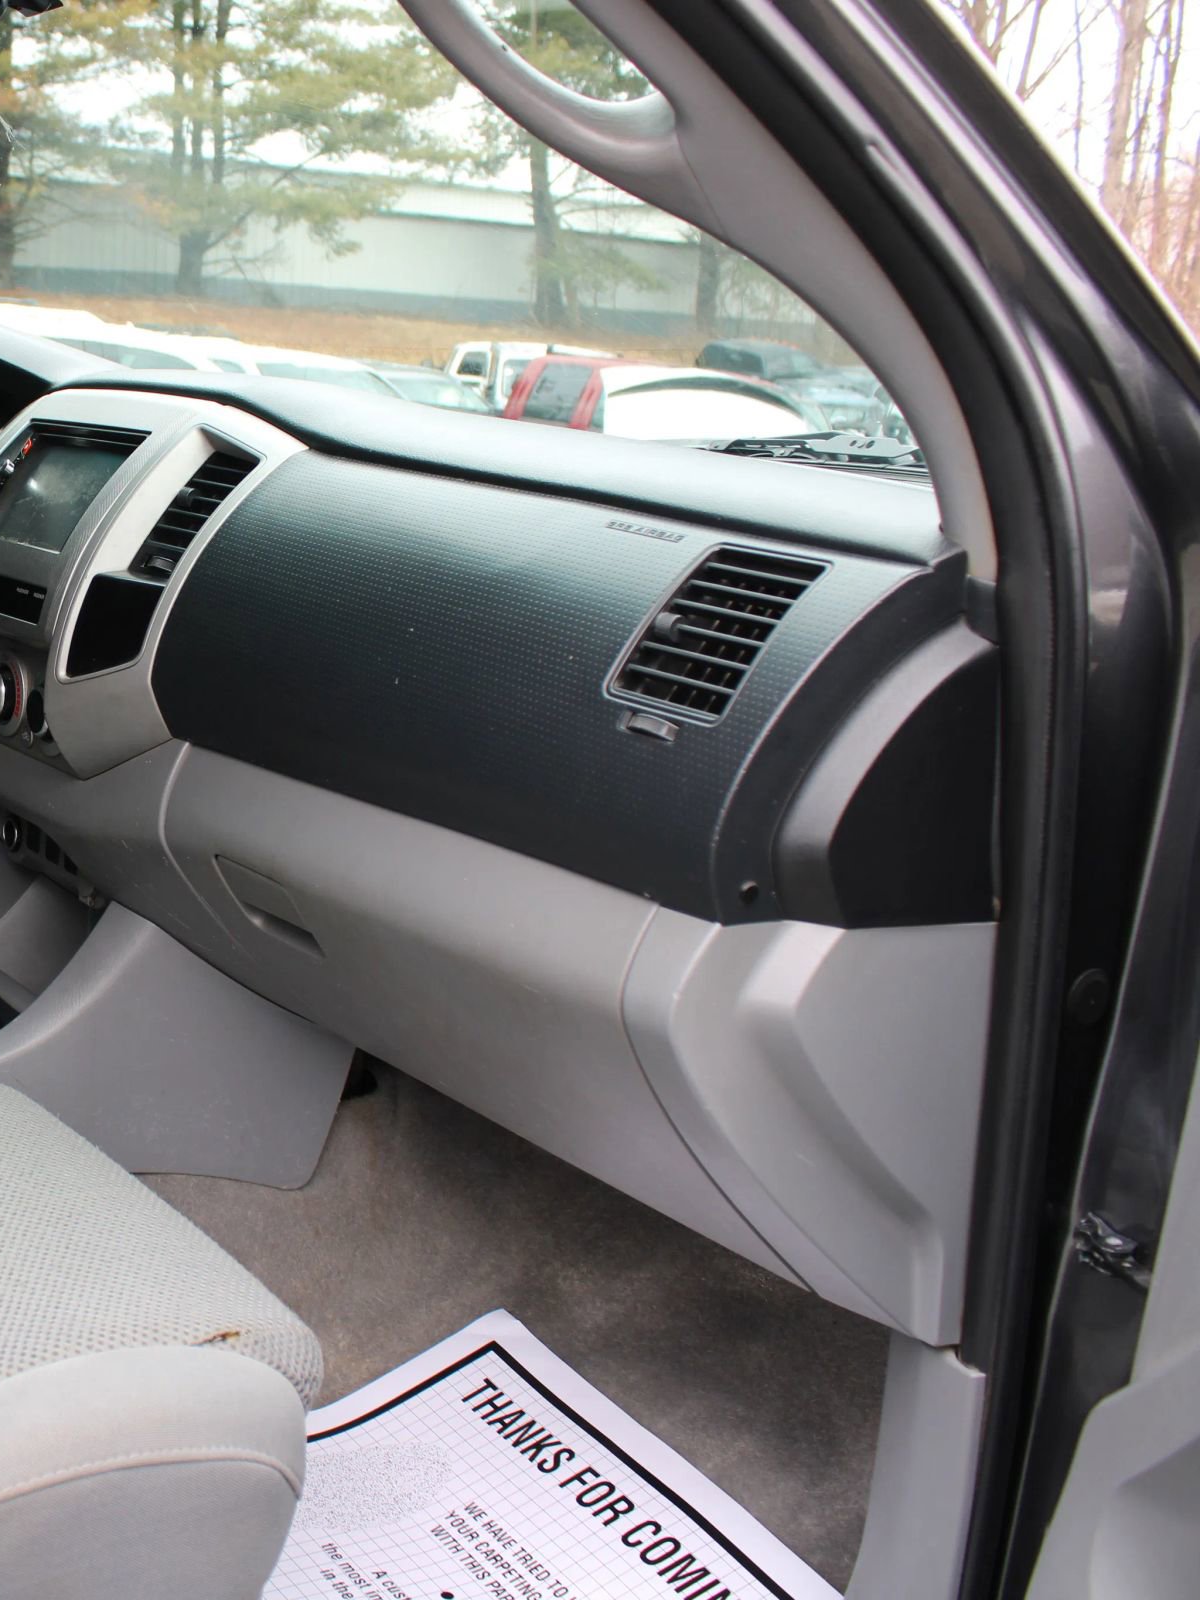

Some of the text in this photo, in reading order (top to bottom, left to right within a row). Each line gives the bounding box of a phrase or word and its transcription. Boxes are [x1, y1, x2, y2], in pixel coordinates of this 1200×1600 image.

[634, 527, 685, 541] AIRBAG
[461, 1378, 575, 1473] THANKS
[559, 1467, 635, 1527] FOR
[321, 1542, 343, 1560] the
[338, 1562, 372, 1589] most
[430, 1524, 465, 1554] WITH
[459, 1553, 491, 1581] THIS
[445, 1510, 542, 1600] YOUR CARPETING
[464, 1502, 569, 1598] WE HAVE TRIED TO
[320, 1568, 354, 1600] in the
[371, 1570, 412, 1600] A cus
